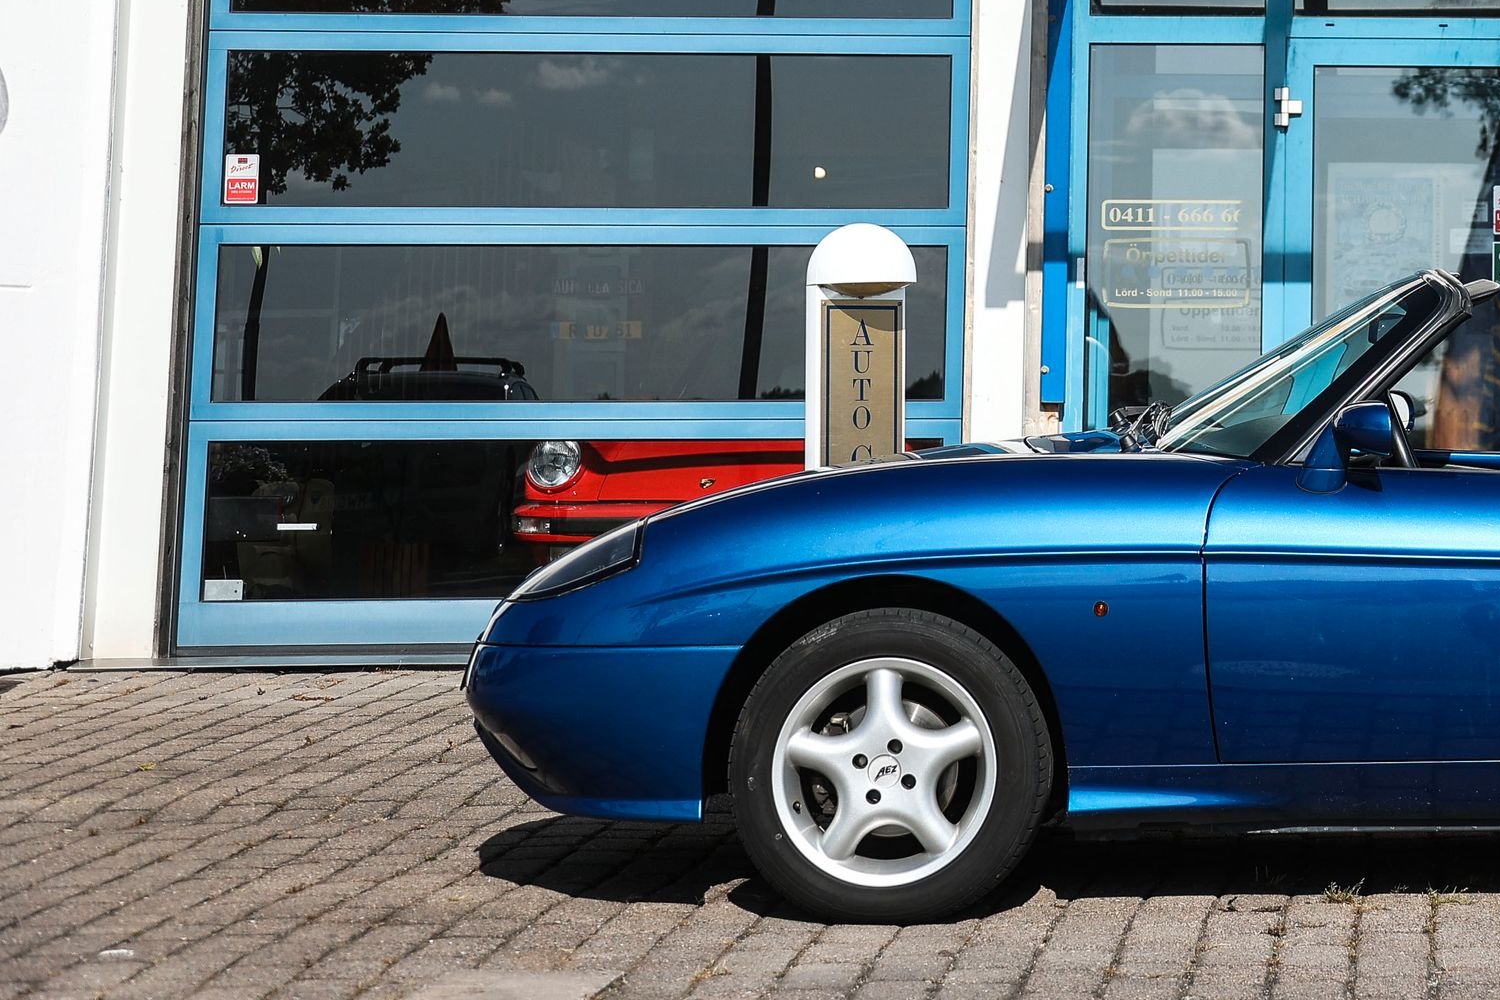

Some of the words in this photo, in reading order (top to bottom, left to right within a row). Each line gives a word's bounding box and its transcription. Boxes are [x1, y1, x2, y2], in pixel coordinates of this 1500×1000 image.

[229, 182, 255, 190] LARM
[1109, 207, 1155, 223] 0411
[1178, 207, 1214, 223] 666
[849, 318, 874, 430] AUTO
[873, 764, 897, 782] AEZ
